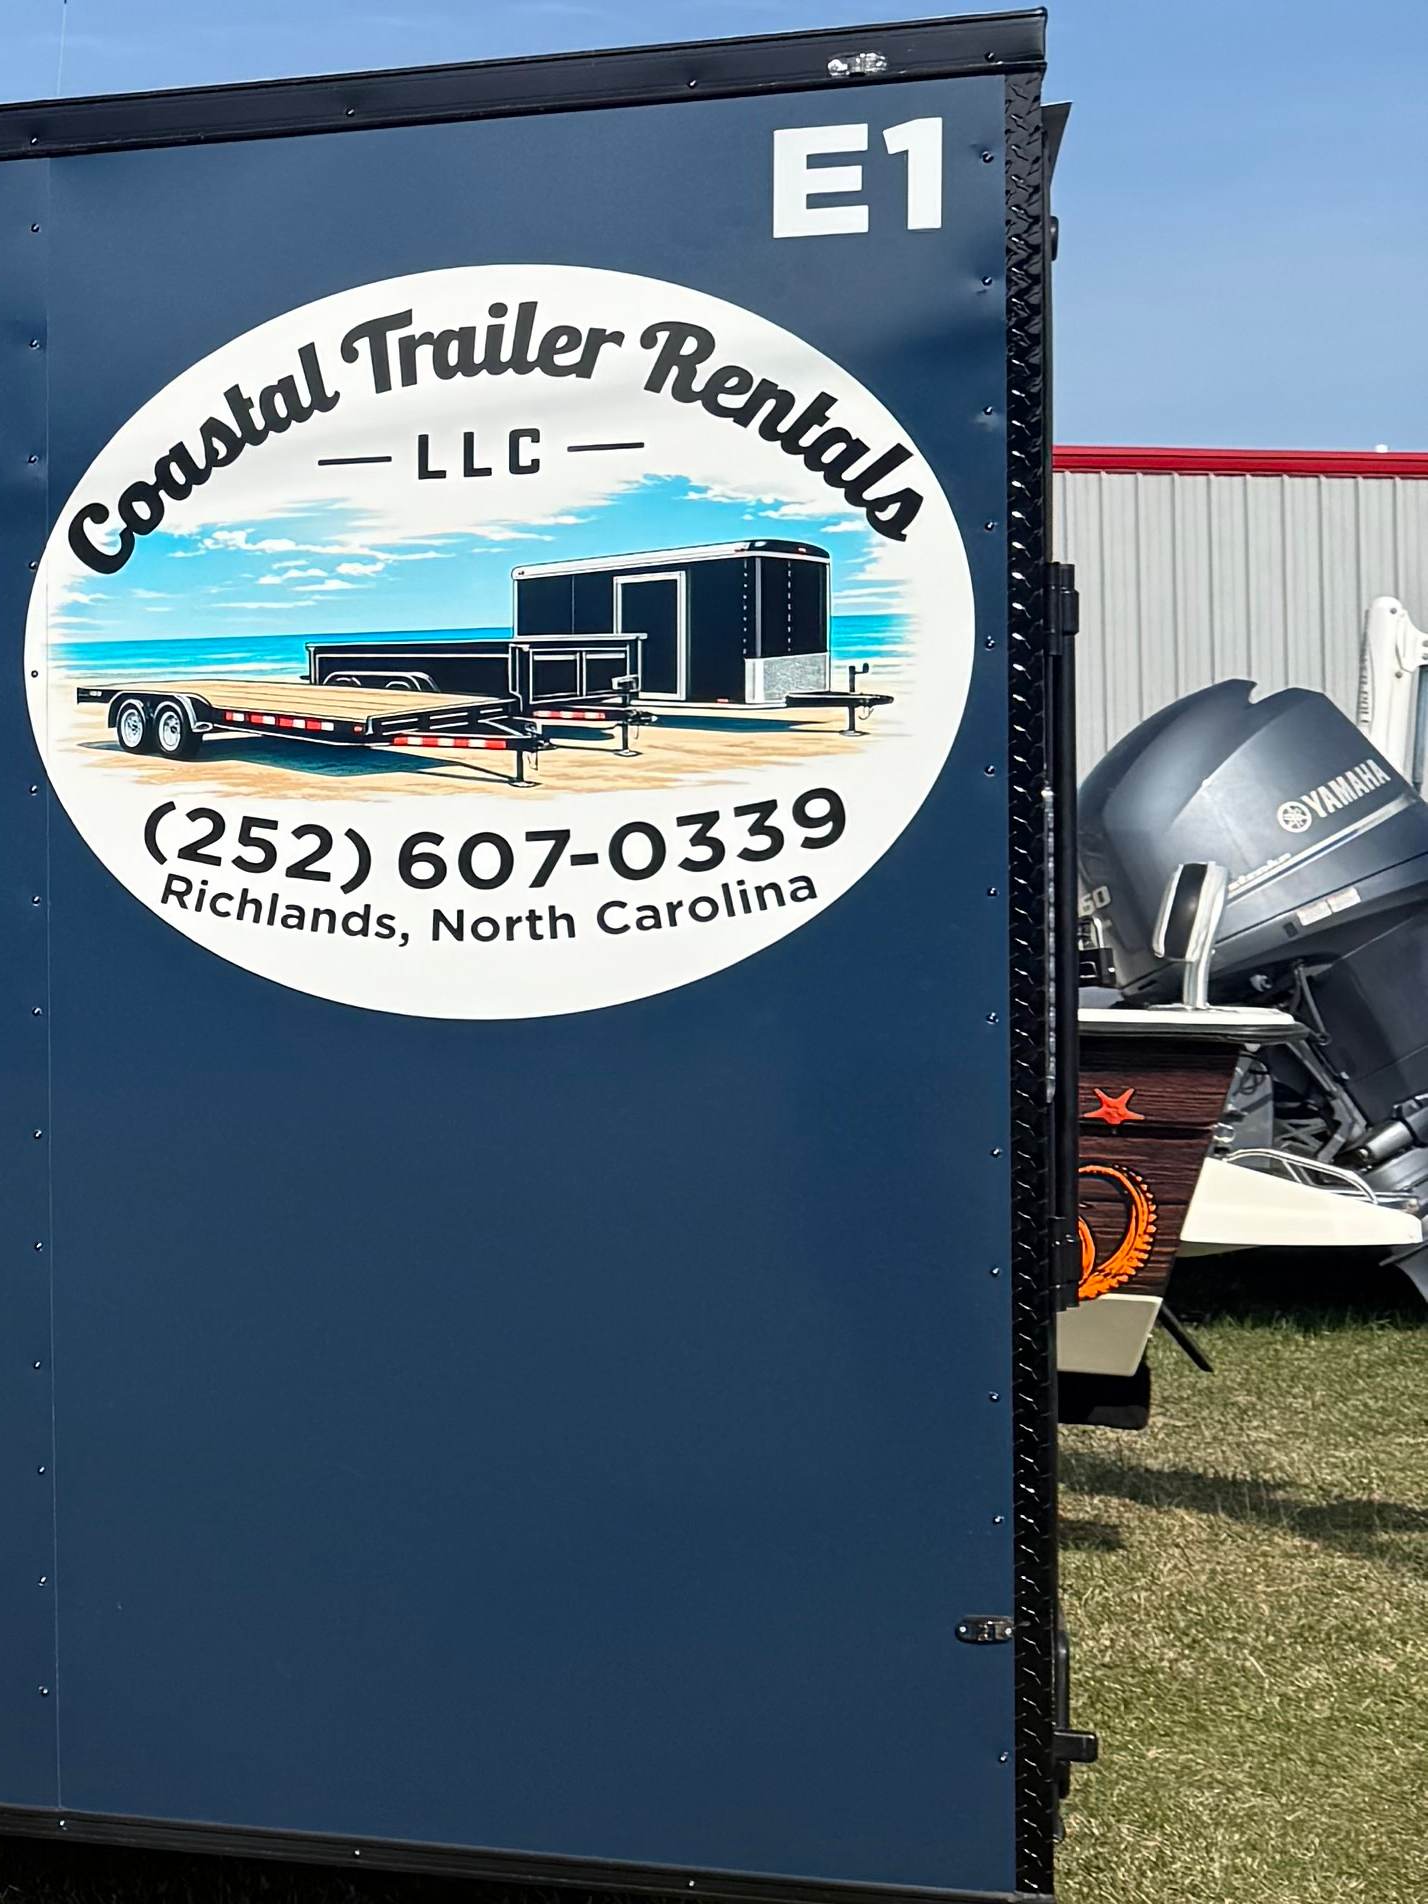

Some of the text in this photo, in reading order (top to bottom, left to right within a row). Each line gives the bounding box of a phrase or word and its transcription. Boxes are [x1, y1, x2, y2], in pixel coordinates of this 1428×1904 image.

[773, 117, 942, 238] E1
[68, 301, 923, 574] Coastal Trailer Rentals
[418, 428, 540, 480] LLC
[1301, 759, 1391, 818] YAMAHA
[144, 788, 846, 894] (252) 607-0339
[161, 873, 817, 947] Richlands, North Carolina
